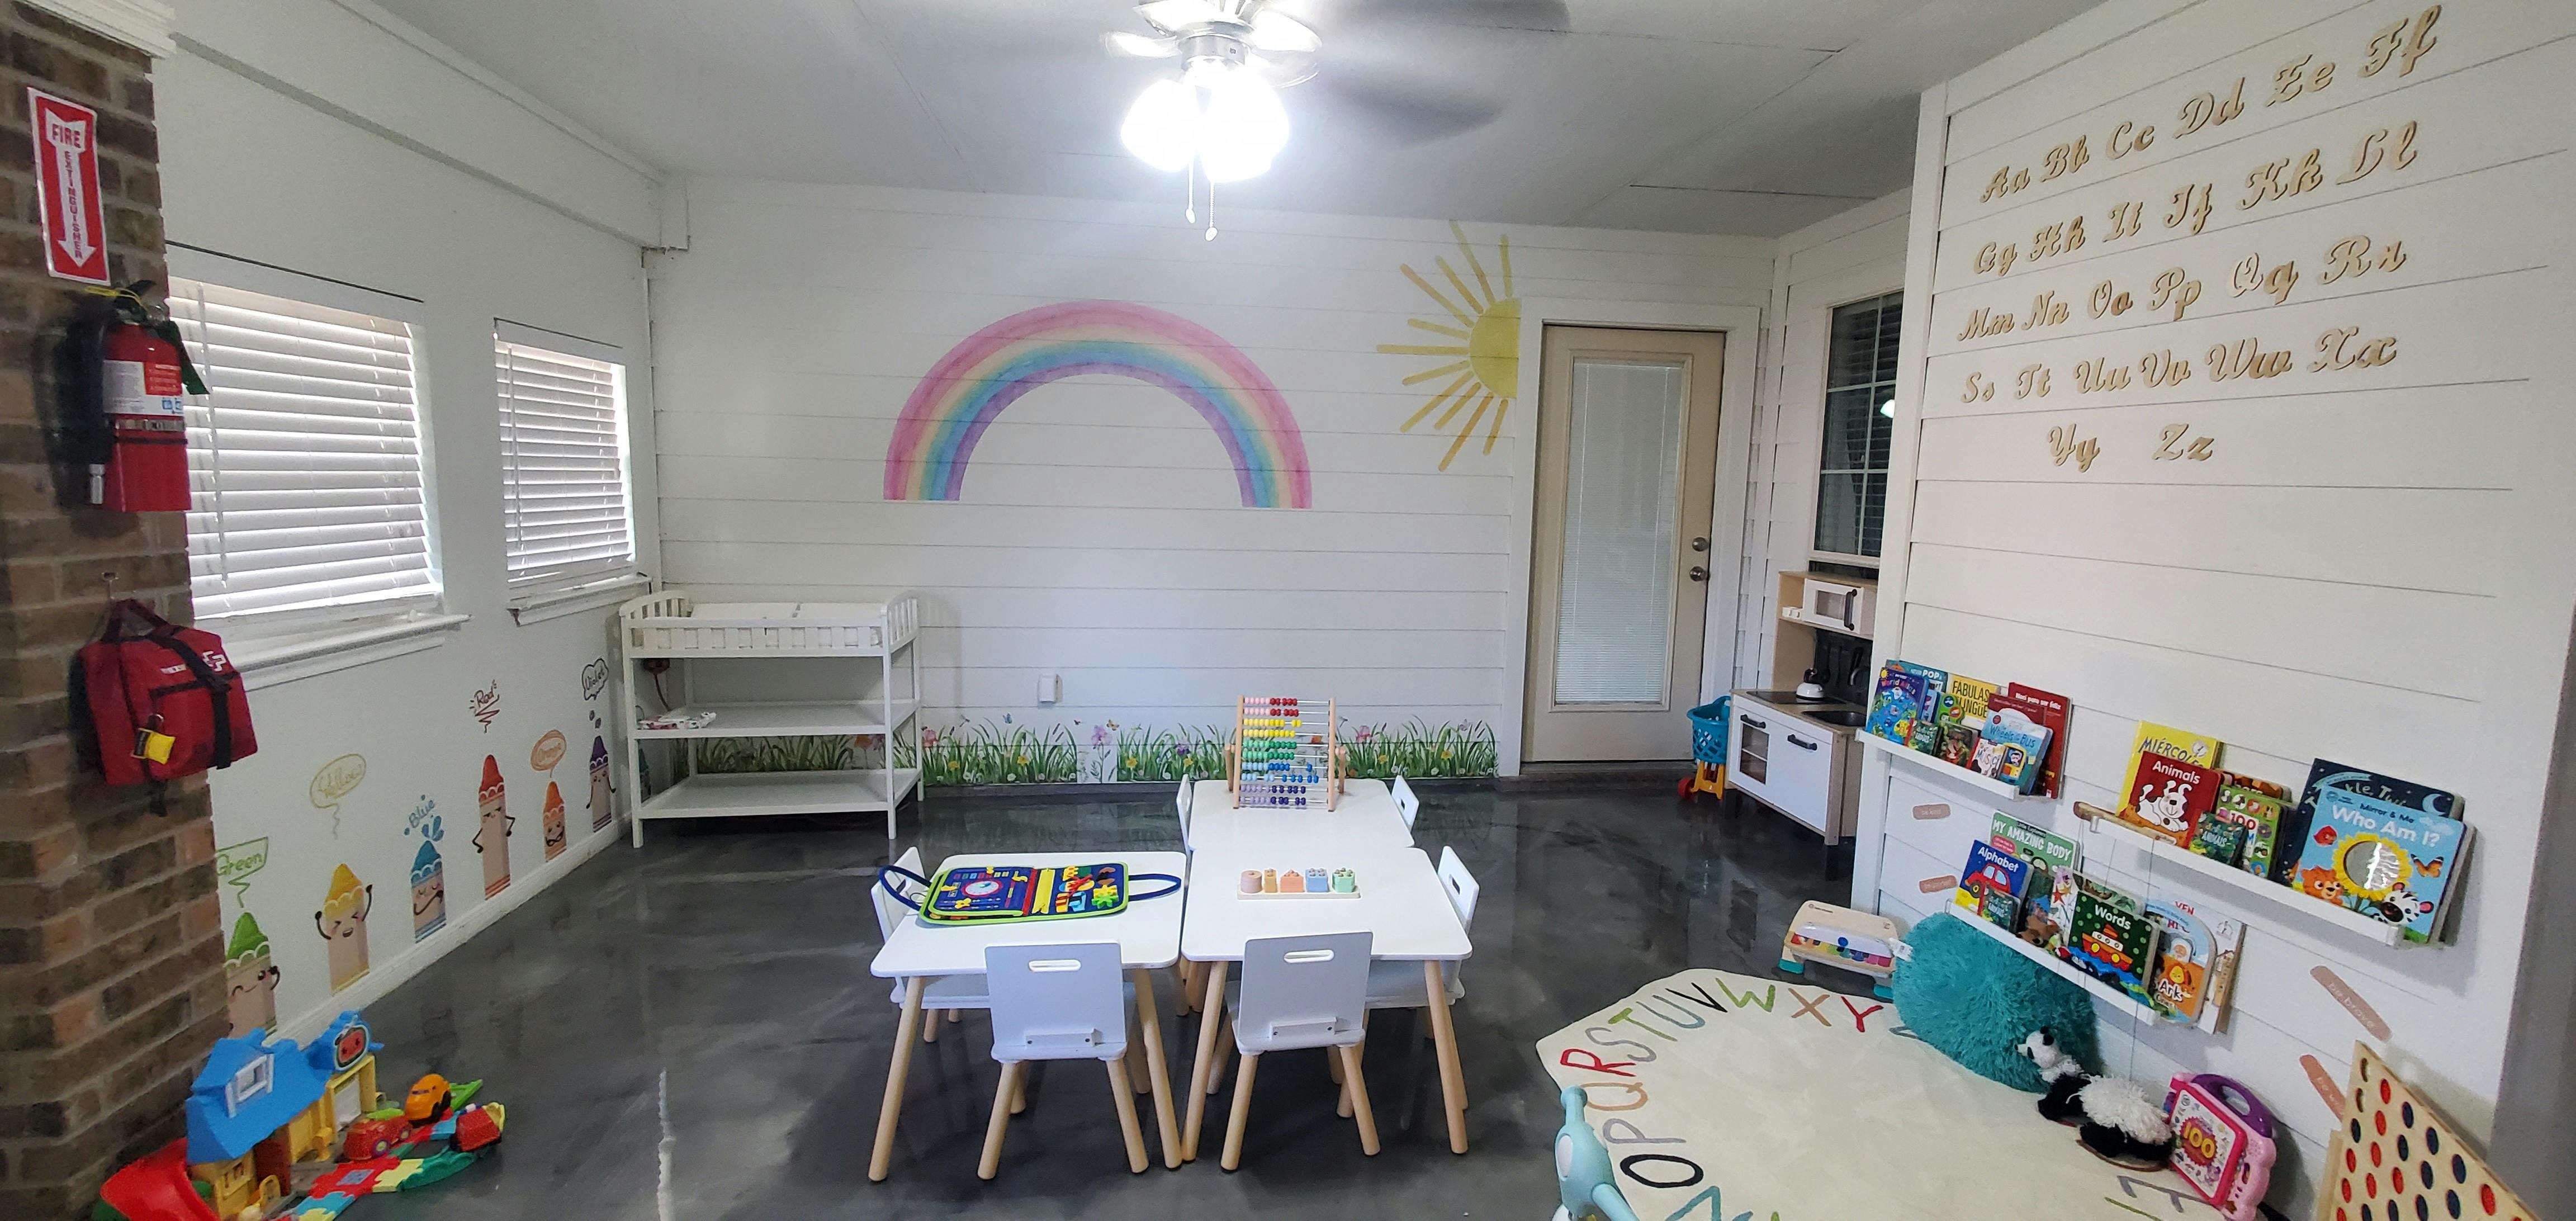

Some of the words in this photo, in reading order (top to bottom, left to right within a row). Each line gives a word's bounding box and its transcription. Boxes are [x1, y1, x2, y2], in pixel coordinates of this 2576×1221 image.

[1980, 165, 2030, 202] Aa
[2039, 135, 2090, 183] Bb
[2105, 120, 2155, 160] Cc
[2173, 77, 2245, 139] Dd
[2266, 54, 2336, 107] Ee
[2357, 4, 2442, 78] Ff
[52, 124, 81, 149] FIRE
[64, 151, 83, 259] EXTINGUISHER
[1973, 242, 2018, 276] Gg
[2029, 215, 2085, 262] Hh
[2103, 201, 2143, 243] Ii
[2162, 183, 2213, 236] Jj
[2237, 149, 2324, 211] Kk
[2336, 121, 2417, 186] Ll
[1956, 302, 2014, 341] Mm
[2020, 290, 2070, 331] Nn
[2086, 281, 2133, 319] Oo
[2147, 266, 2201, 321] Pp
[2225, 252, 2299, 304] Qq
[2317, 235, 2407, 285] Rr
[1961, 372, 1996, 403] Ss
[2013, 363, 2051, 399] Tt
[2072, 357, 2132, 394] Uu
[2137, 349, 2191, 387] Vv
[2204, 337, 2293, 382] Ww
[2307, 326, 2397, 373] Xx
[2047, 424, 2100, 472] Yy
[2151, 423, 2215, 461] Zz
[474, 685, 494, 708] Red
[2152, 760, 2200, 784] Animals
[409, 800, 434, 829] Blue
[2332, 804, 2376, 830] Who
[2380, 821, 2416, 842] Am
[2422, 830, 2440, 848] I?
[2360, 803, 2386, 816] Mirror
[1992, 819, 2006, 834] MY
[2007, 826, 2044, 850] AMAZING
[2047, 842, 2072, 861] BODY
[215, 853, 262, 876] Green
[1978, 846, 2019, 873] Alphabet
[2095, 905, 2131, 930] Words
[2184, 1121, 2215, 1159] 100
